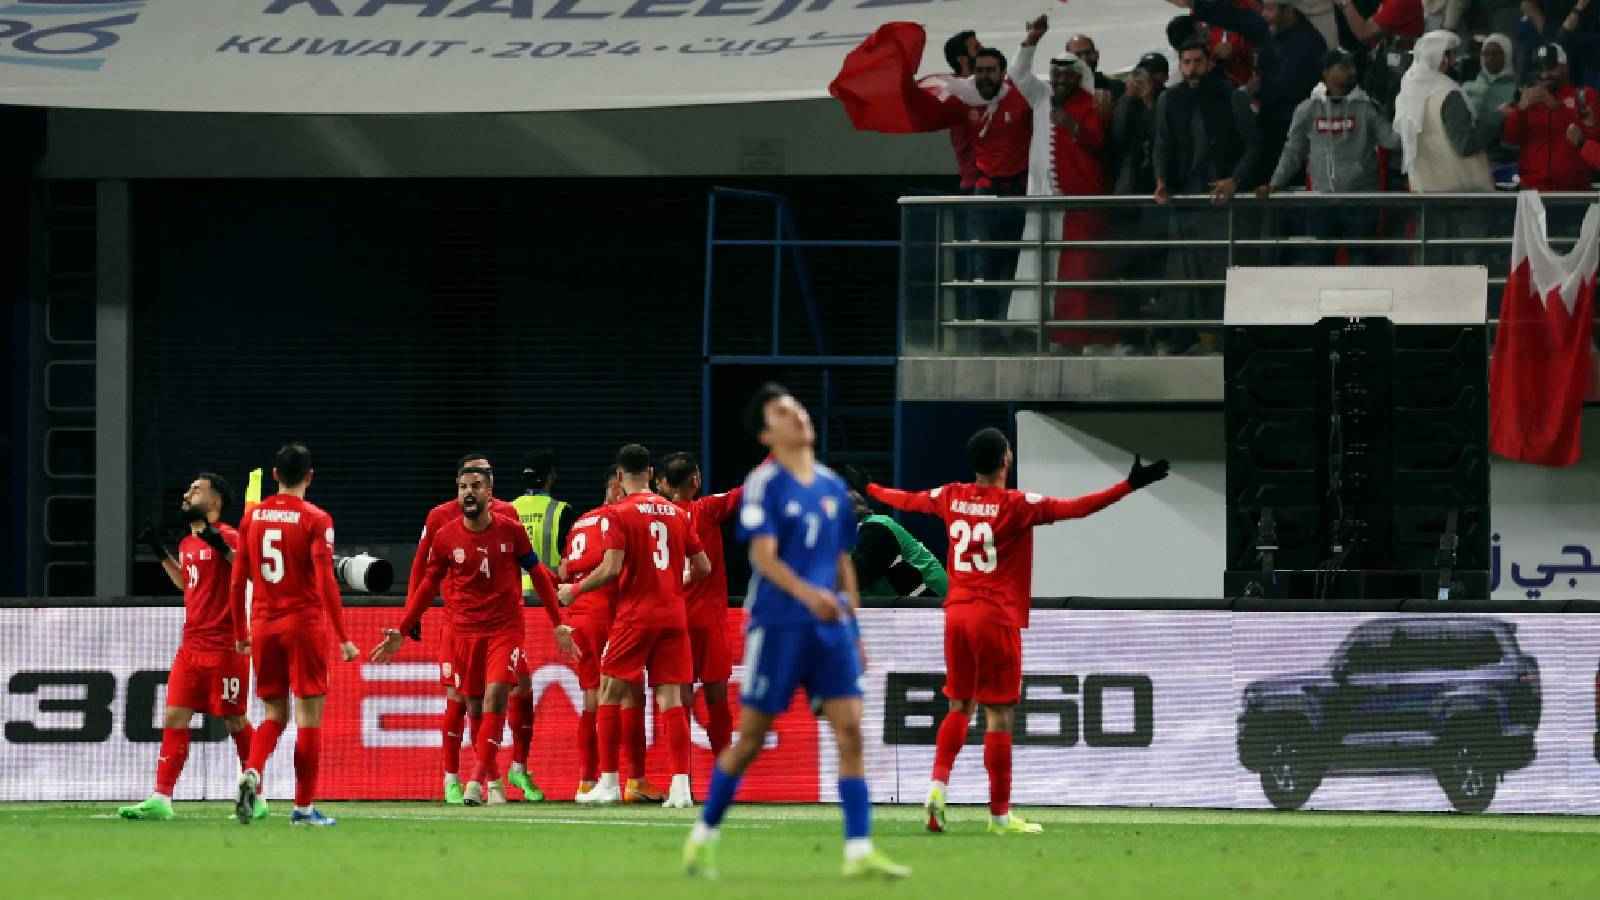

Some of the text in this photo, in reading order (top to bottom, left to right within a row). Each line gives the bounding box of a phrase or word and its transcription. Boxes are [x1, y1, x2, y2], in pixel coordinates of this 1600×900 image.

[216, 35, 467, 57] KUWAIT
[492, 41, 640, 59] 2024
[261, 528, 285, 584] 5
[479, 558, 491, 579] 4
[650, 521, 670, 571] 3
[949, 520, 997, 573] 23
[221, 677, 240, 700] 19
[882, 672, 1153, 747] B60
